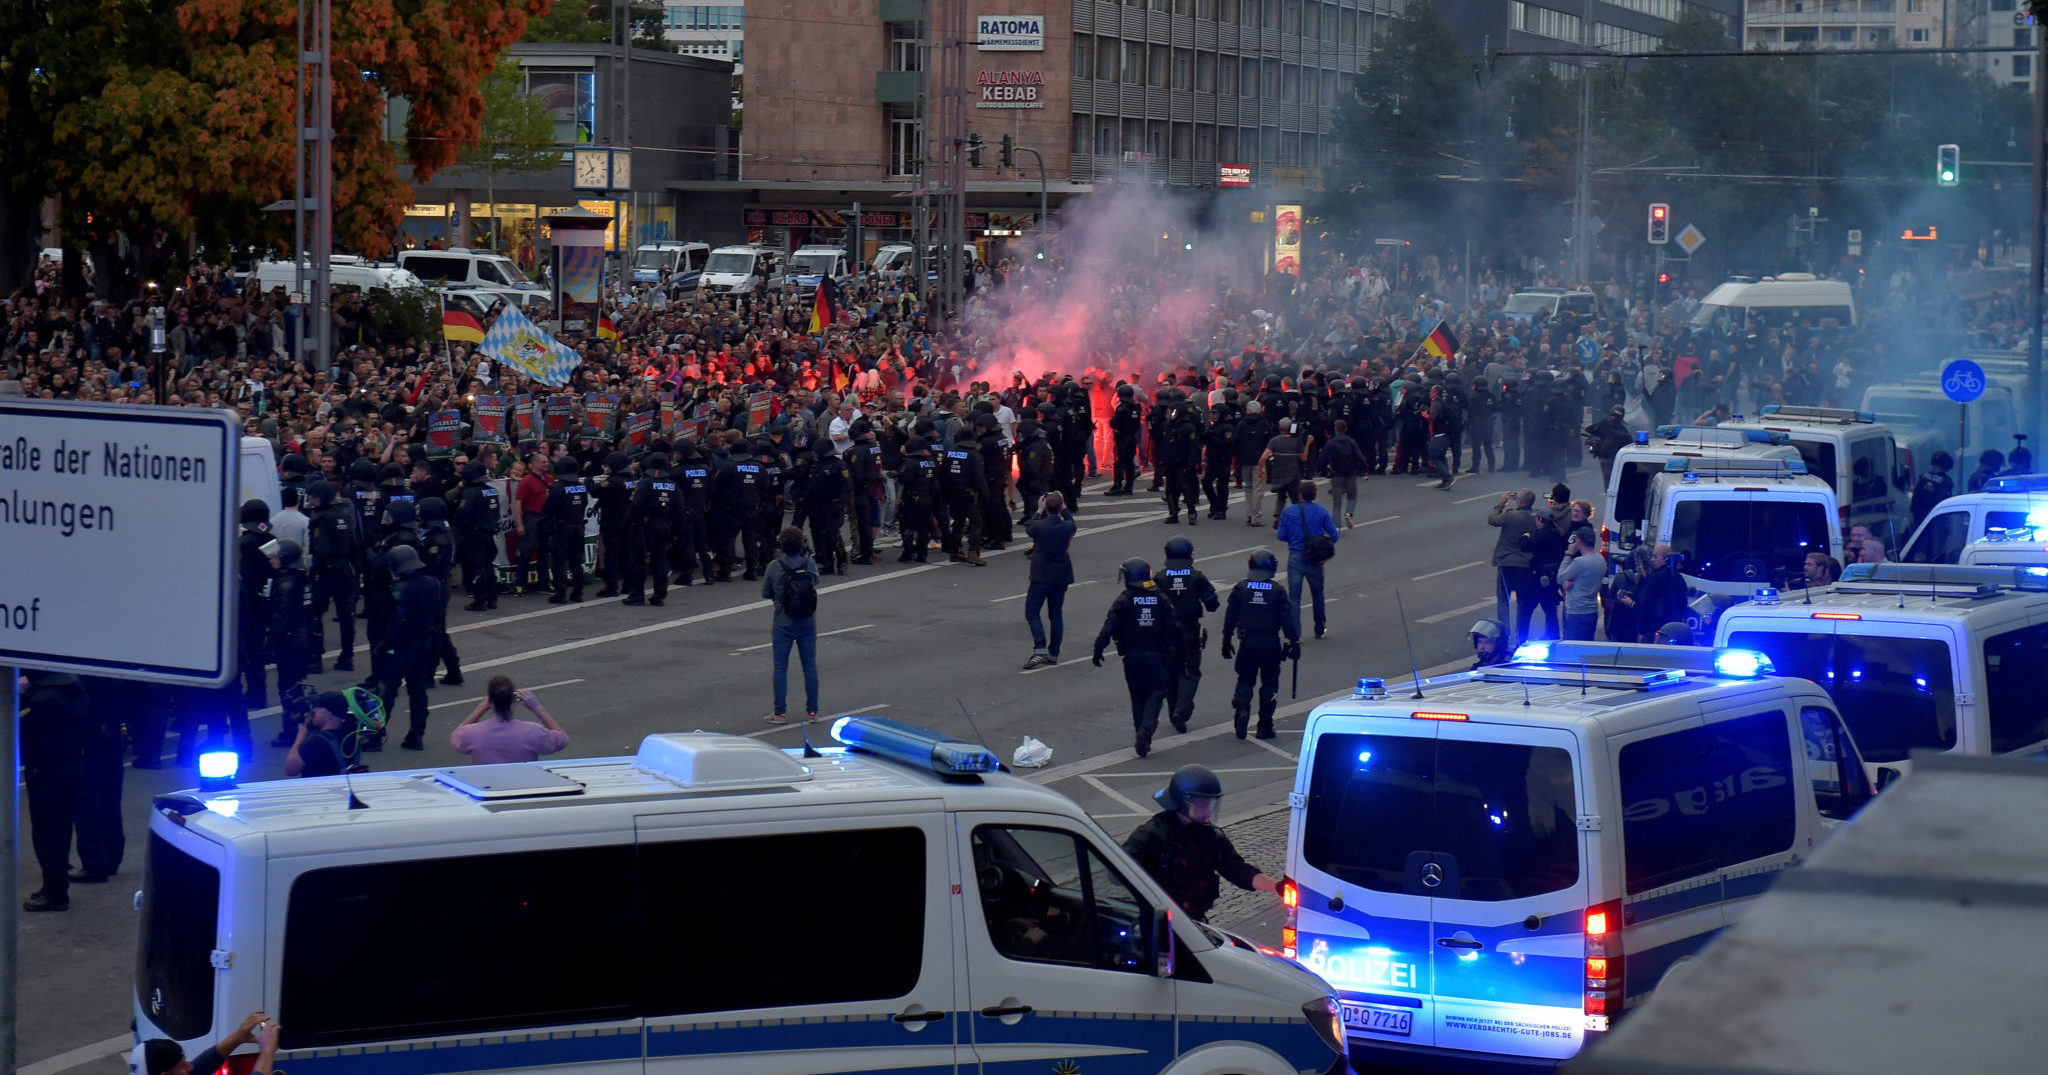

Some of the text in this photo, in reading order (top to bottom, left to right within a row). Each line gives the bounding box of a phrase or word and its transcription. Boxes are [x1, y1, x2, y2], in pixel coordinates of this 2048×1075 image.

[980, 20, 1041, 34] RATOMA
[978, 70, 1043, 84] ALANYA
[982, 86, 1037, 101] KEBAB
[54, 439, 91, 476] der
[104, 441, 207, 483] Nationen
[737, 465, 760, 473] POLIZEI
[1247, 581, 1273, 590] POLIZEI
[1133, 596, 1158, 605] POLIZEI
[1309, 953, 1417, 989] POLIZEI
[1360, 1008, 1370, 1025] Q
[1373, 1011, 1408, 1030] 7716
[1445, 1021, 1572, 1039] WWW.VERDAECHTIG-GUTE-JOBS.DE
